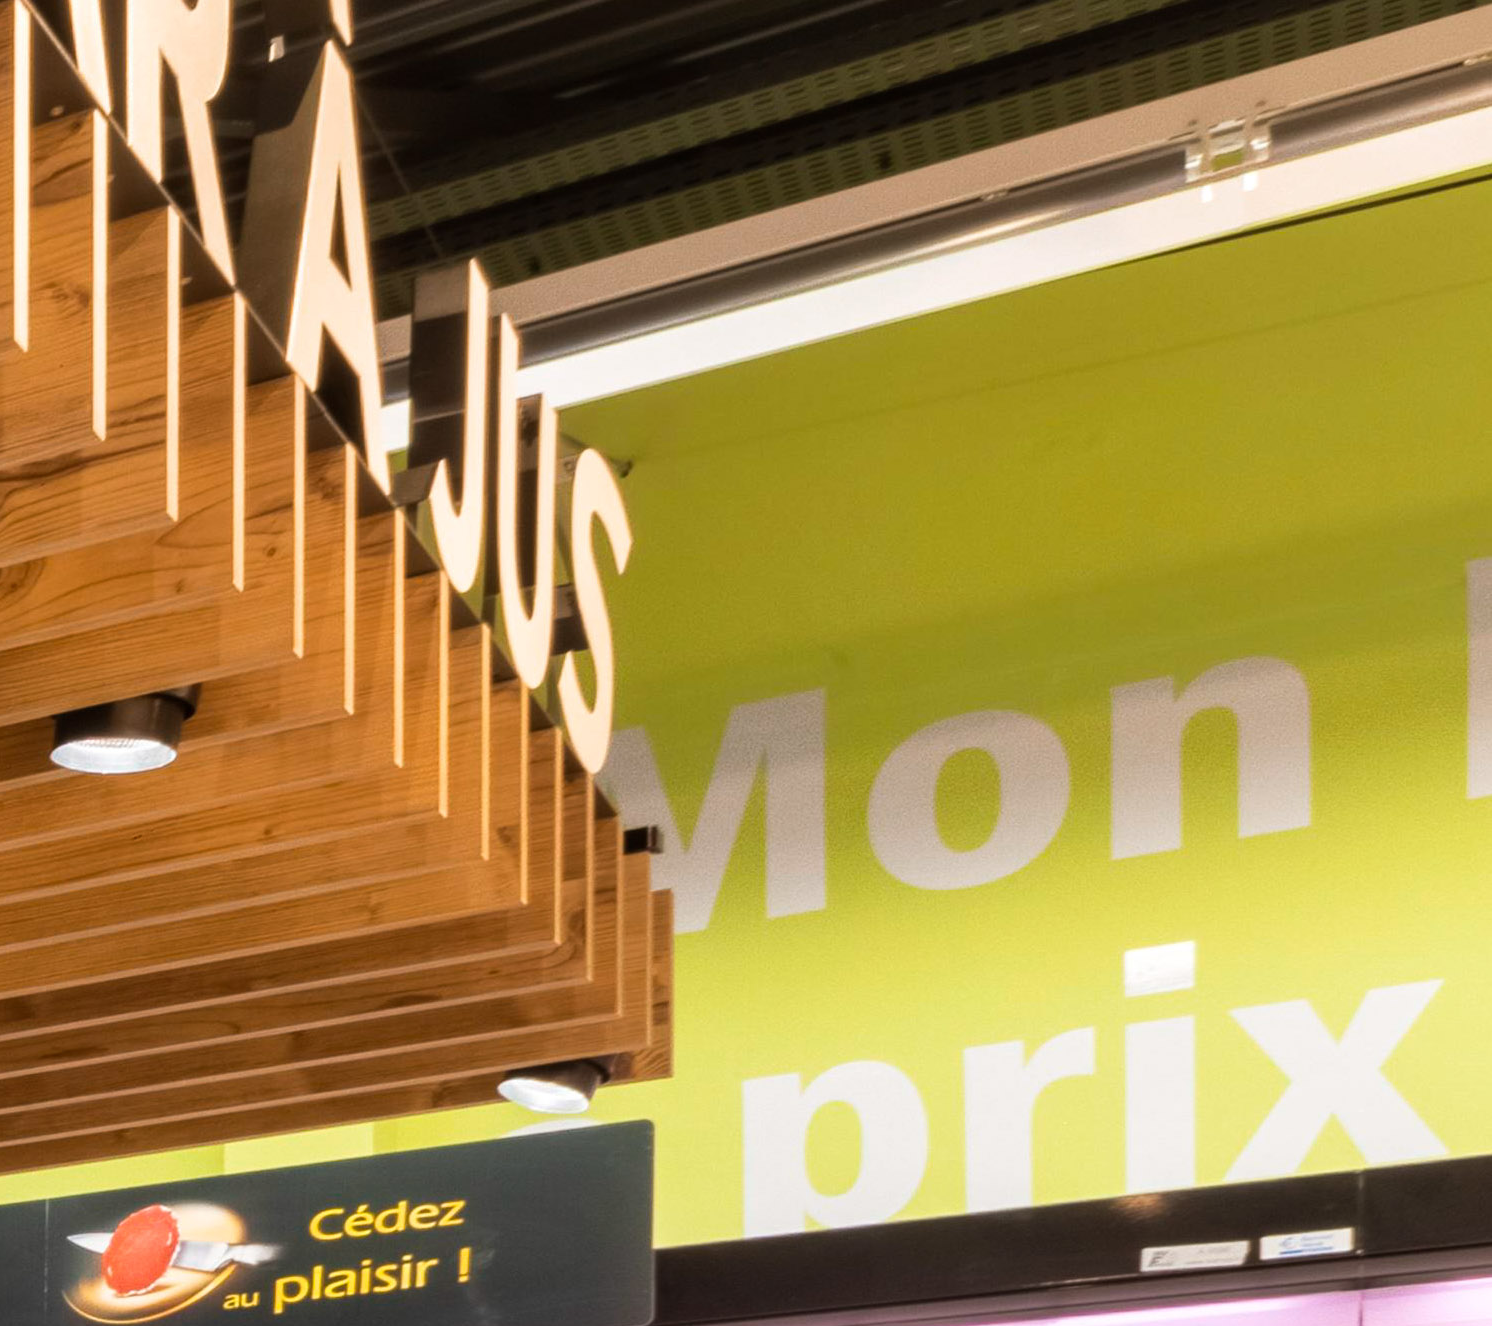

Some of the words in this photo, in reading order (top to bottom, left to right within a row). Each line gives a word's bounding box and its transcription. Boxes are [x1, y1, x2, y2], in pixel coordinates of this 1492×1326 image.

[594, 655, 1311, 934] Mon
[742, 941, 1449, 1238] prix
[223, 1289, 258, 1311] au
[274, 1256, 439, 1314] plaisir
[309, 1199, 465, 1242] Cédez
